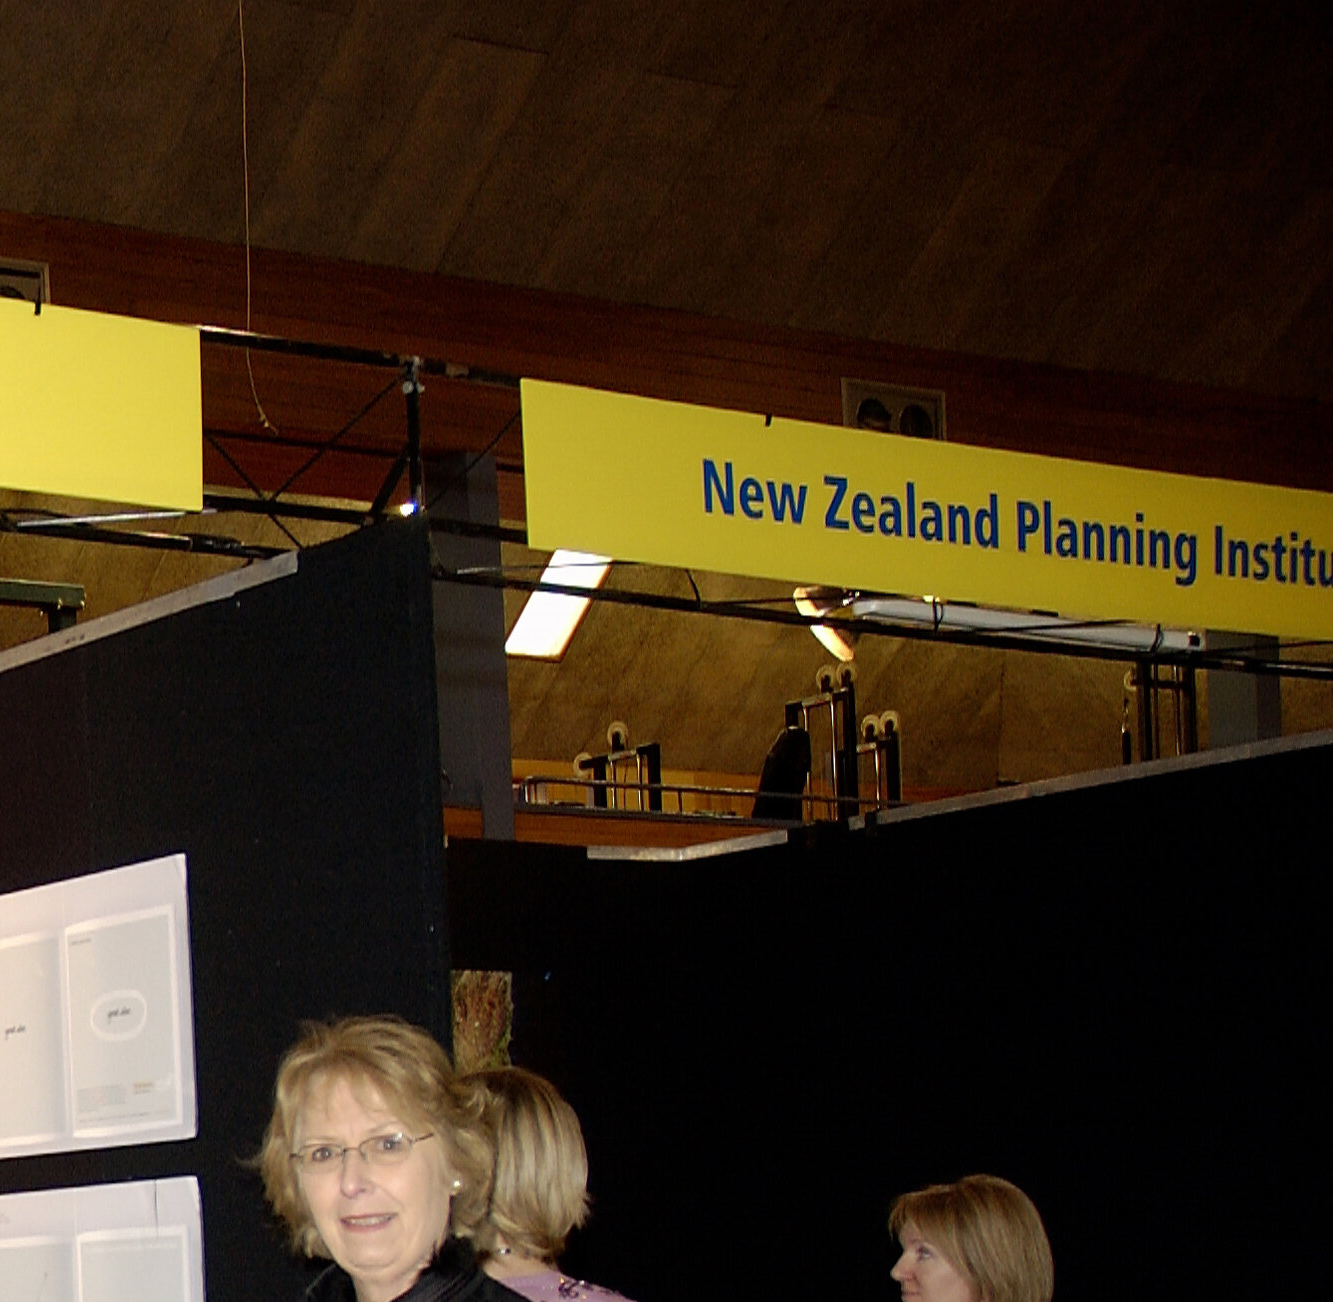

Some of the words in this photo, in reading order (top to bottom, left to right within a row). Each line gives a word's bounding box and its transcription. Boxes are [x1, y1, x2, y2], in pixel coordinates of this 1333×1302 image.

[701, 457, 808, 526] New
[823, 474, 1000, 550] Zealand
[1015, 498, 1198, 587] Planning
[1213, 525, 1333, 588] Institu
